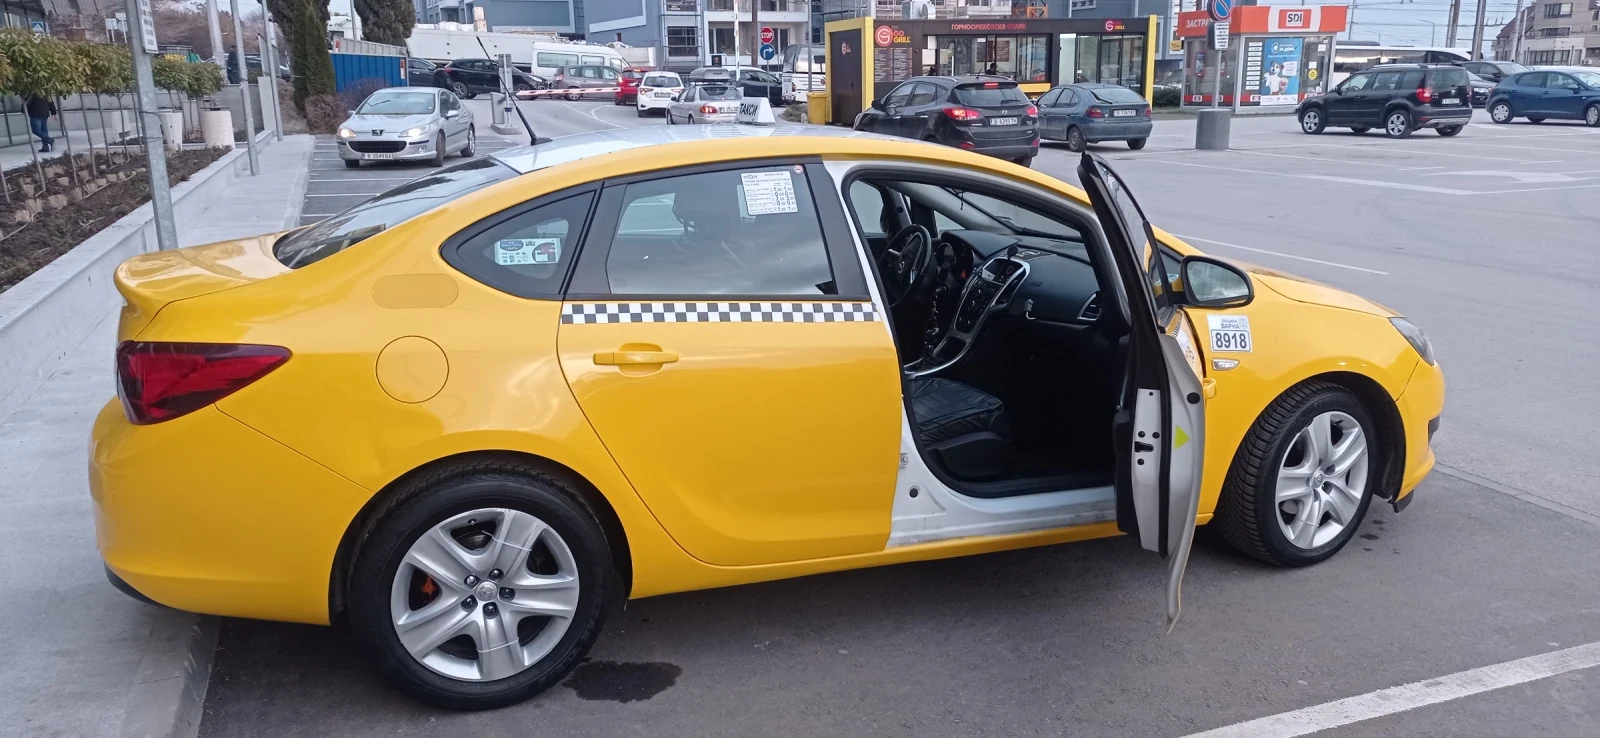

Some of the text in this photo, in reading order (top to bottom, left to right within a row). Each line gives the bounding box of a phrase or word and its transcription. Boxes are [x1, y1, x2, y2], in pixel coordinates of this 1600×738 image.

[1288, 13, 1303, 23] SDI
[739, 103, 759, 116] ТАКСИ
[1215, 332, 1247, 349] 8918
